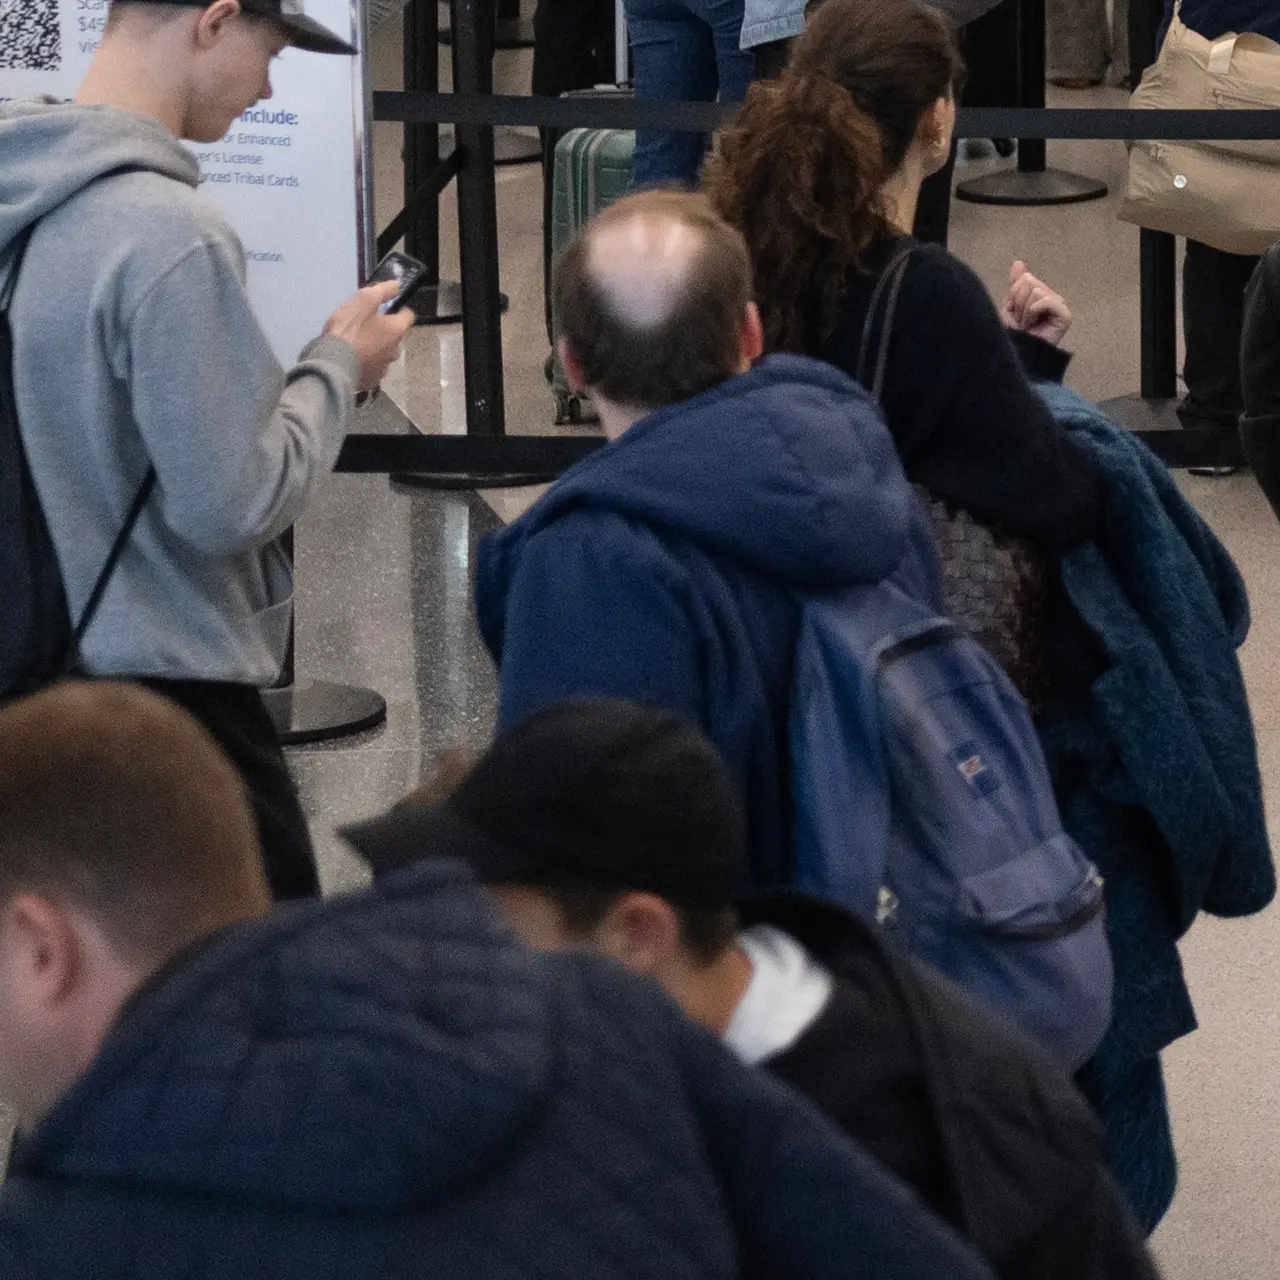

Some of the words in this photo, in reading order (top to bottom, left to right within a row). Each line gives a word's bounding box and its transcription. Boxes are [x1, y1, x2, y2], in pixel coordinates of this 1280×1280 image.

[237, 132, 292, 148] Enhanced
[222, 151, 264, 165] License
[234, 171, 266, 185] Tribal
[268, 173, 300, 188] Cards
